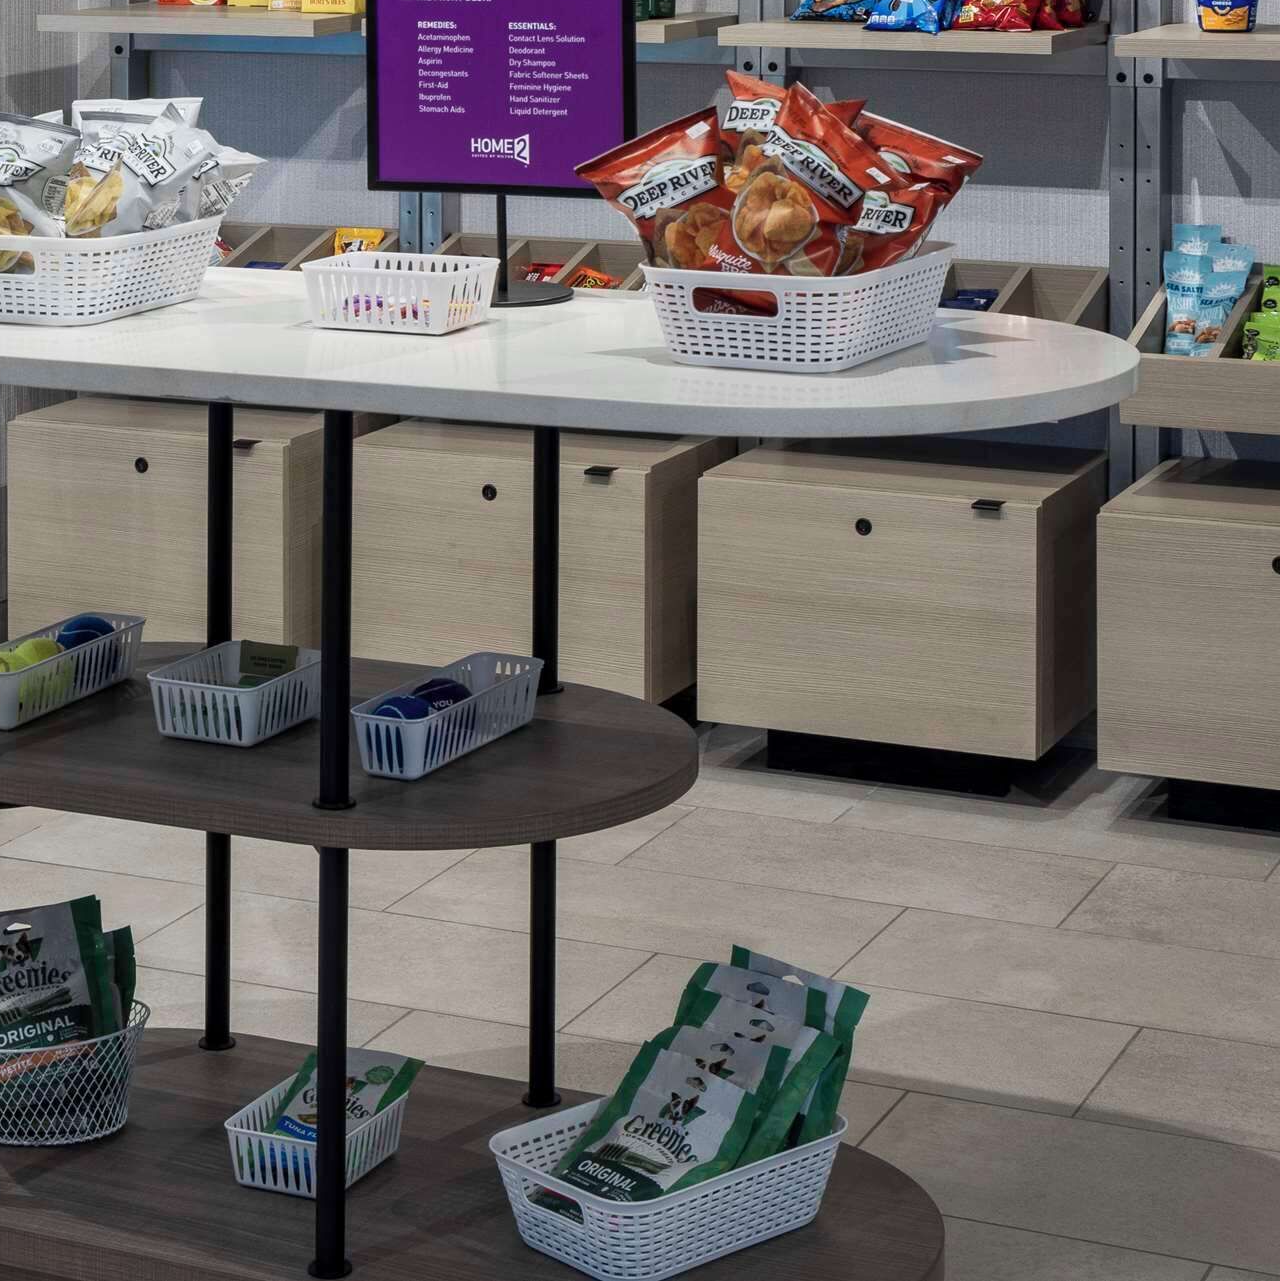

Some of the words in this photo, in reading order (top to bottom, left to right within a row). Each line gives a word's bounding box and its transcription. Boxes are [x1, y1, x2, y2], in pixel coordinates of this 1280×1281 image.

[417, 21, 457, 30] REMEDIES:
[508, 22, 556, 31] ESSENTIALS:
[417, 34, 470, 42] Acetaminophen
[508, 35, 535, 43] Contact
[537, 35, 554, 43] Lens
[555, 35, 585, 43] Solution
[418, 46, 442, 55] Allergy
[443, 46, 474, 54] Medicine
[509, 47, 545, 55] Deodorant
[418, 57, 442, 66] Aspirin
[509, 59, 519, 68] Dry
[521, 59, 556, 68] Shampoo
[418, 70, 469, 78] Decongestants
[509, 71, 531, 80] Fabric
[532, 71, 563, 80] Softener
[564, 71, 589, 80] Sheets
[418, 81, 449, 89] First-Aid
[509, 83, 542, 91] Feminine
[543, 83, 572, 93] Hygiene
[419, 93, 451, 102] Ibuprofen
[509, 95, 528, 103] Hand
[529, 95, 561, 104] Sanitizer
[419, 105, 449, 113] Stomach
[450, 105, 466, 114] Aids
[510, 107, 532, 116] Liquid
[533, 107, 568, 117] Detergent
[727, 106, 770, 122] DEEP
[766, 130, 803, 156] DEEP
[800, 154, 855, 202] RIVER
[623, 182, 668, 212] DEEP
[862, 208, 907, 229] RIVER
[433, 700, 454, 708] YOU
[283, 1120, 306, 1136] TUNA
[623, 1114, 698, 1163] Greenies
[577, 1159, 638, 1192] ORIGINAL
